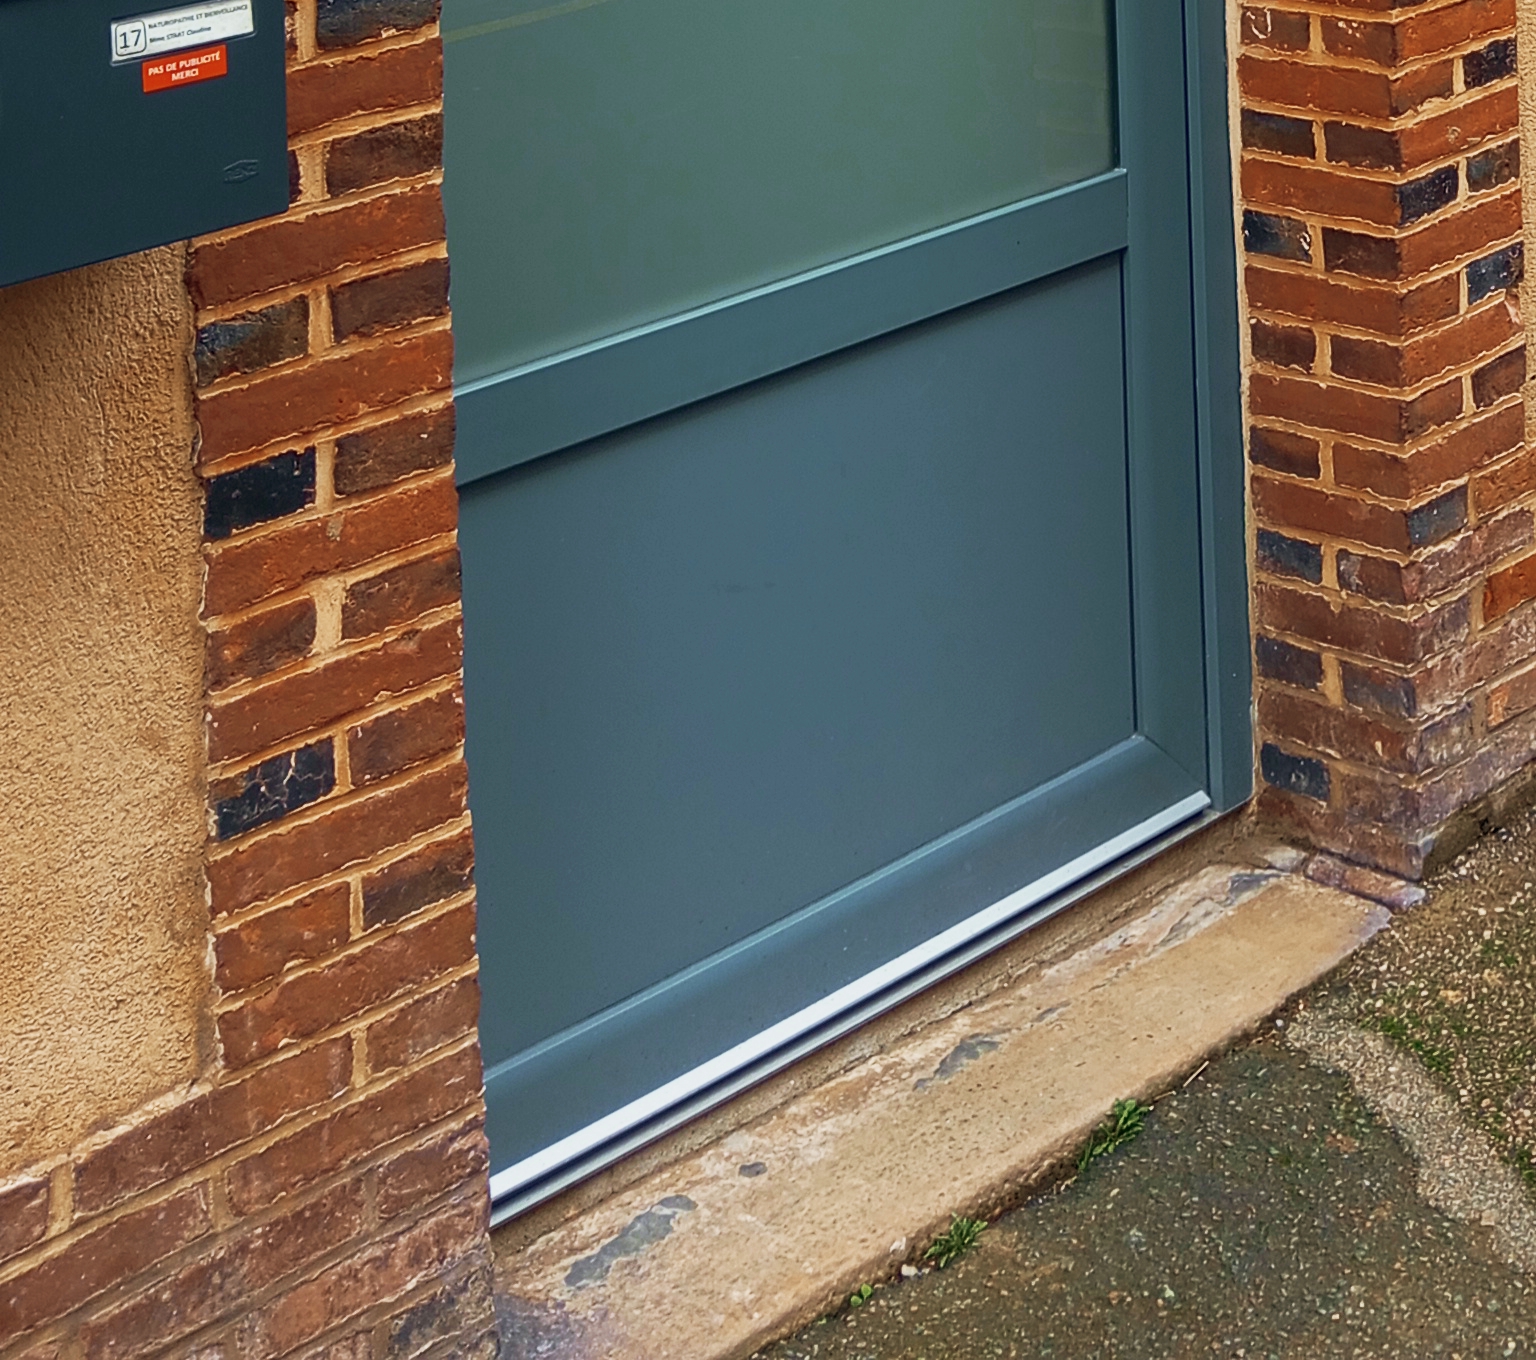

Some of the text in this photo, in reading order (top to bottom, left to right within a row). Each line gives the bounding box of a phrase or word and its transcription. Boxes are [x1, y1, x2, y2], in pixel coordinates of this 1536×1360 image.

[119, 28, 142, 50] 17
[148, 50, 221, 76] PAS DE PUBLICITÉ
[171, 68, 199, 82] MERCI
